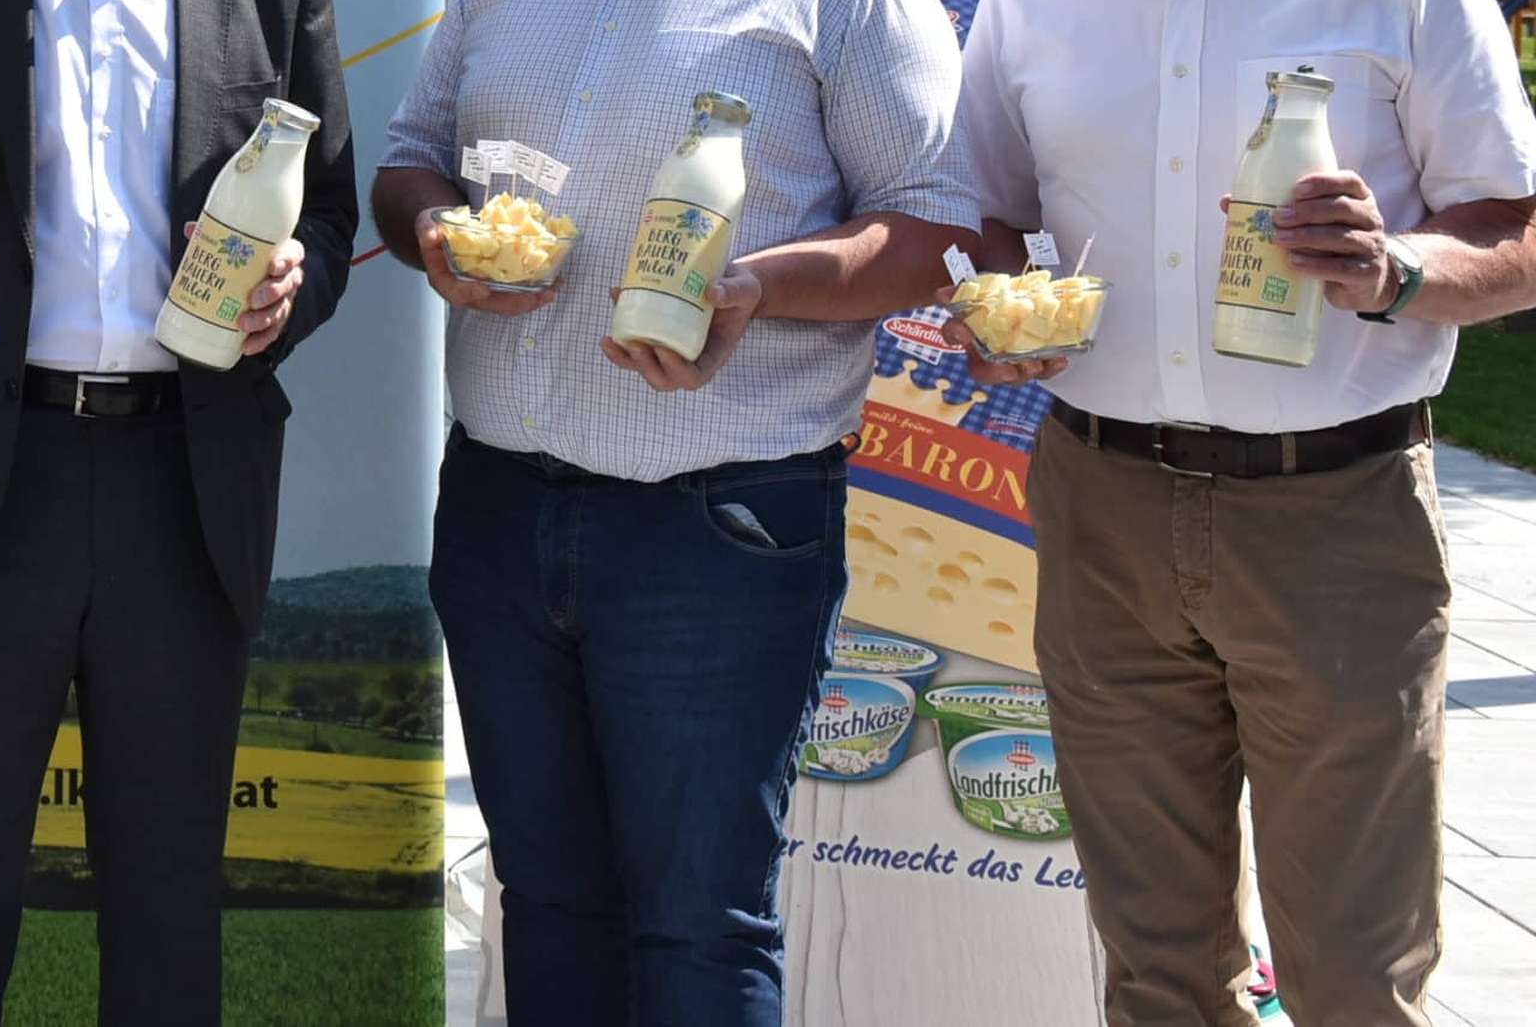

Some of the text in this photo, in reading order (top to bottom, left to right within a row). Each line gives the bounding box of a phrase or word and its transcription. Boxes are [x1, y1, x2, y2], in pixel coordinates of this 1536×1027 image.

[855, 424, 1026, 511] BARON
[813, 835, 959, 876] schmeckt
[967, 848, 1023, 883] das
